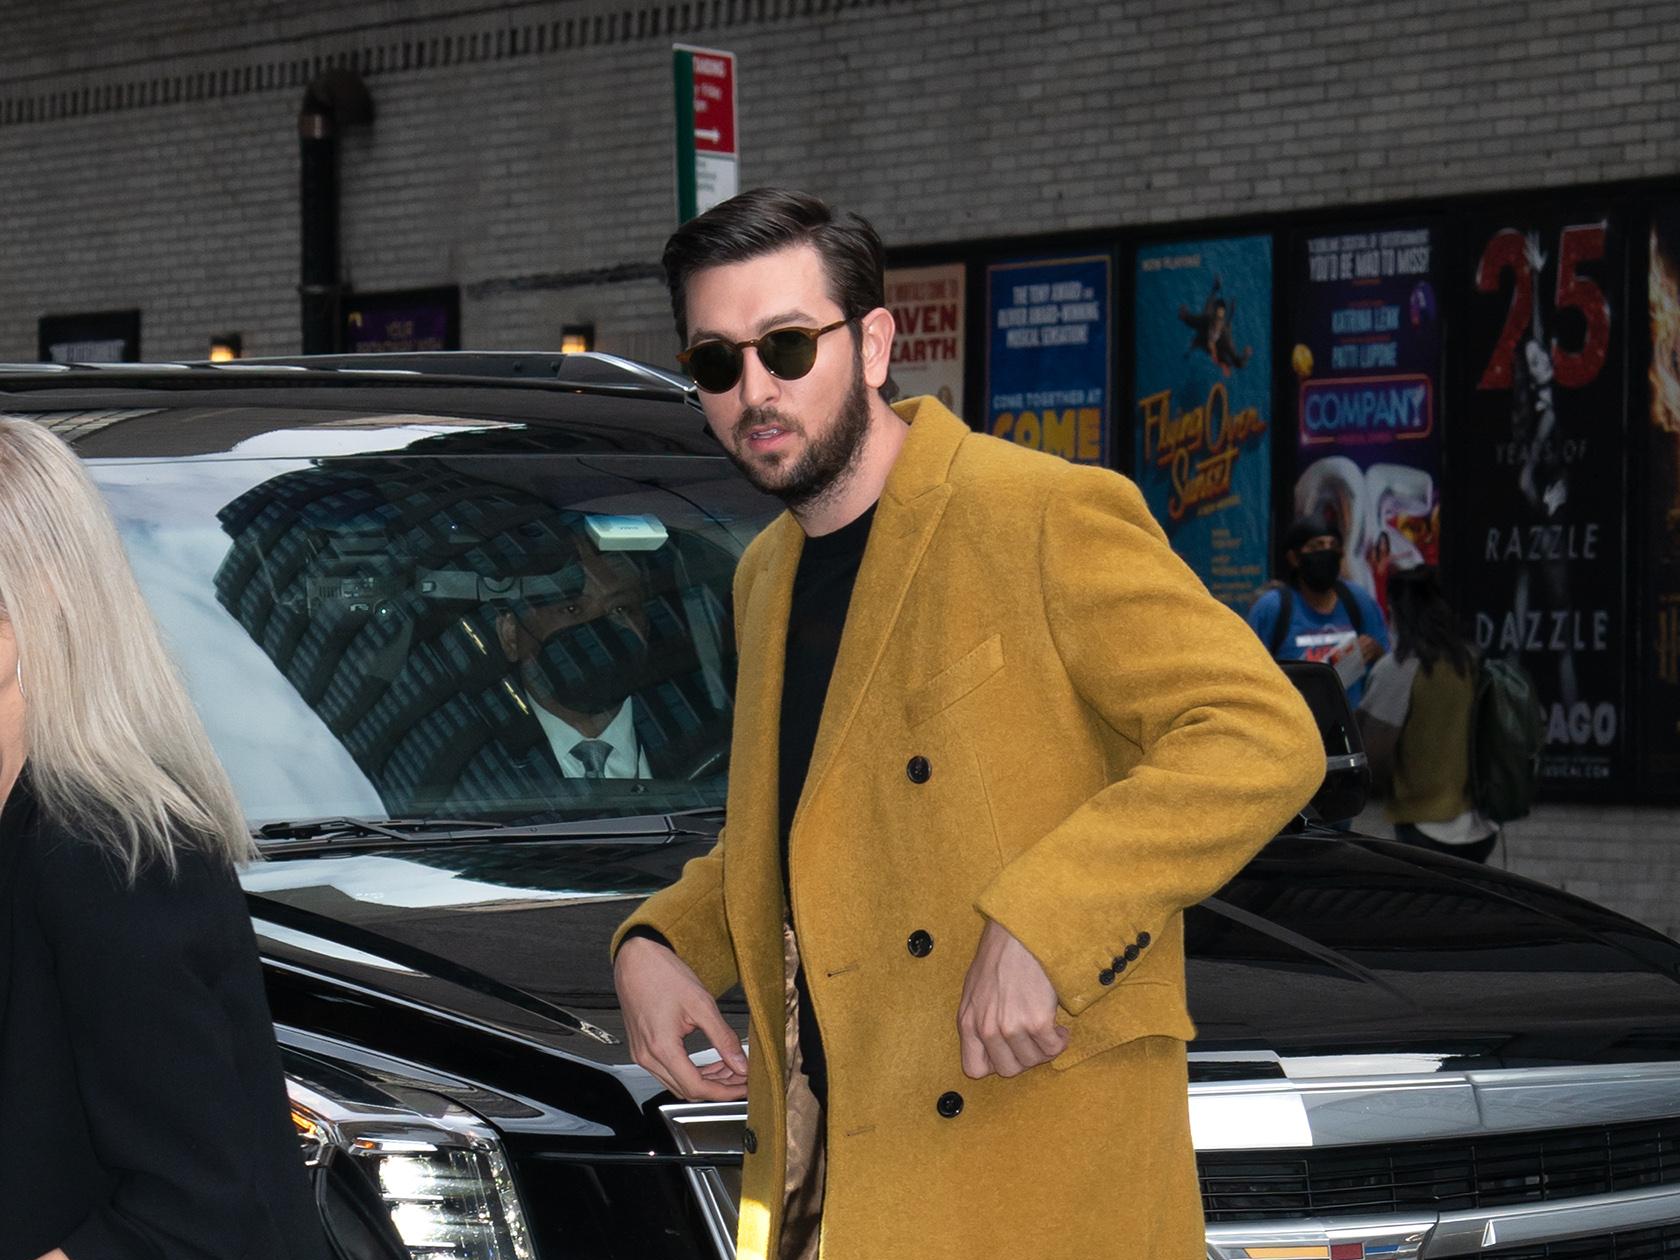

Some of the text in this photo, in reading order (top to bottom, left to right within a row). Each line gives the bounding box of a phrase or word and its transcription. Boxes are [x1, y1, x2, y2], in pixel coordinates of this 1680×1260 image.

[892, 302, 957, 335] AVEN
[1475, 219, 1612, 391] 25
[1026, 389, 1085, 408] TOGETHER
[1205, 383, 1267, 454] Over
[1306, 383, 1427, 431] COMPANY
[992, 407, 1101, 460] COME
[1168, 447, 1240, 519] Sunset
[1485, 523, 1599, 561] RAZZLE
[1475, 611, 1610, 651] DAZZLE
